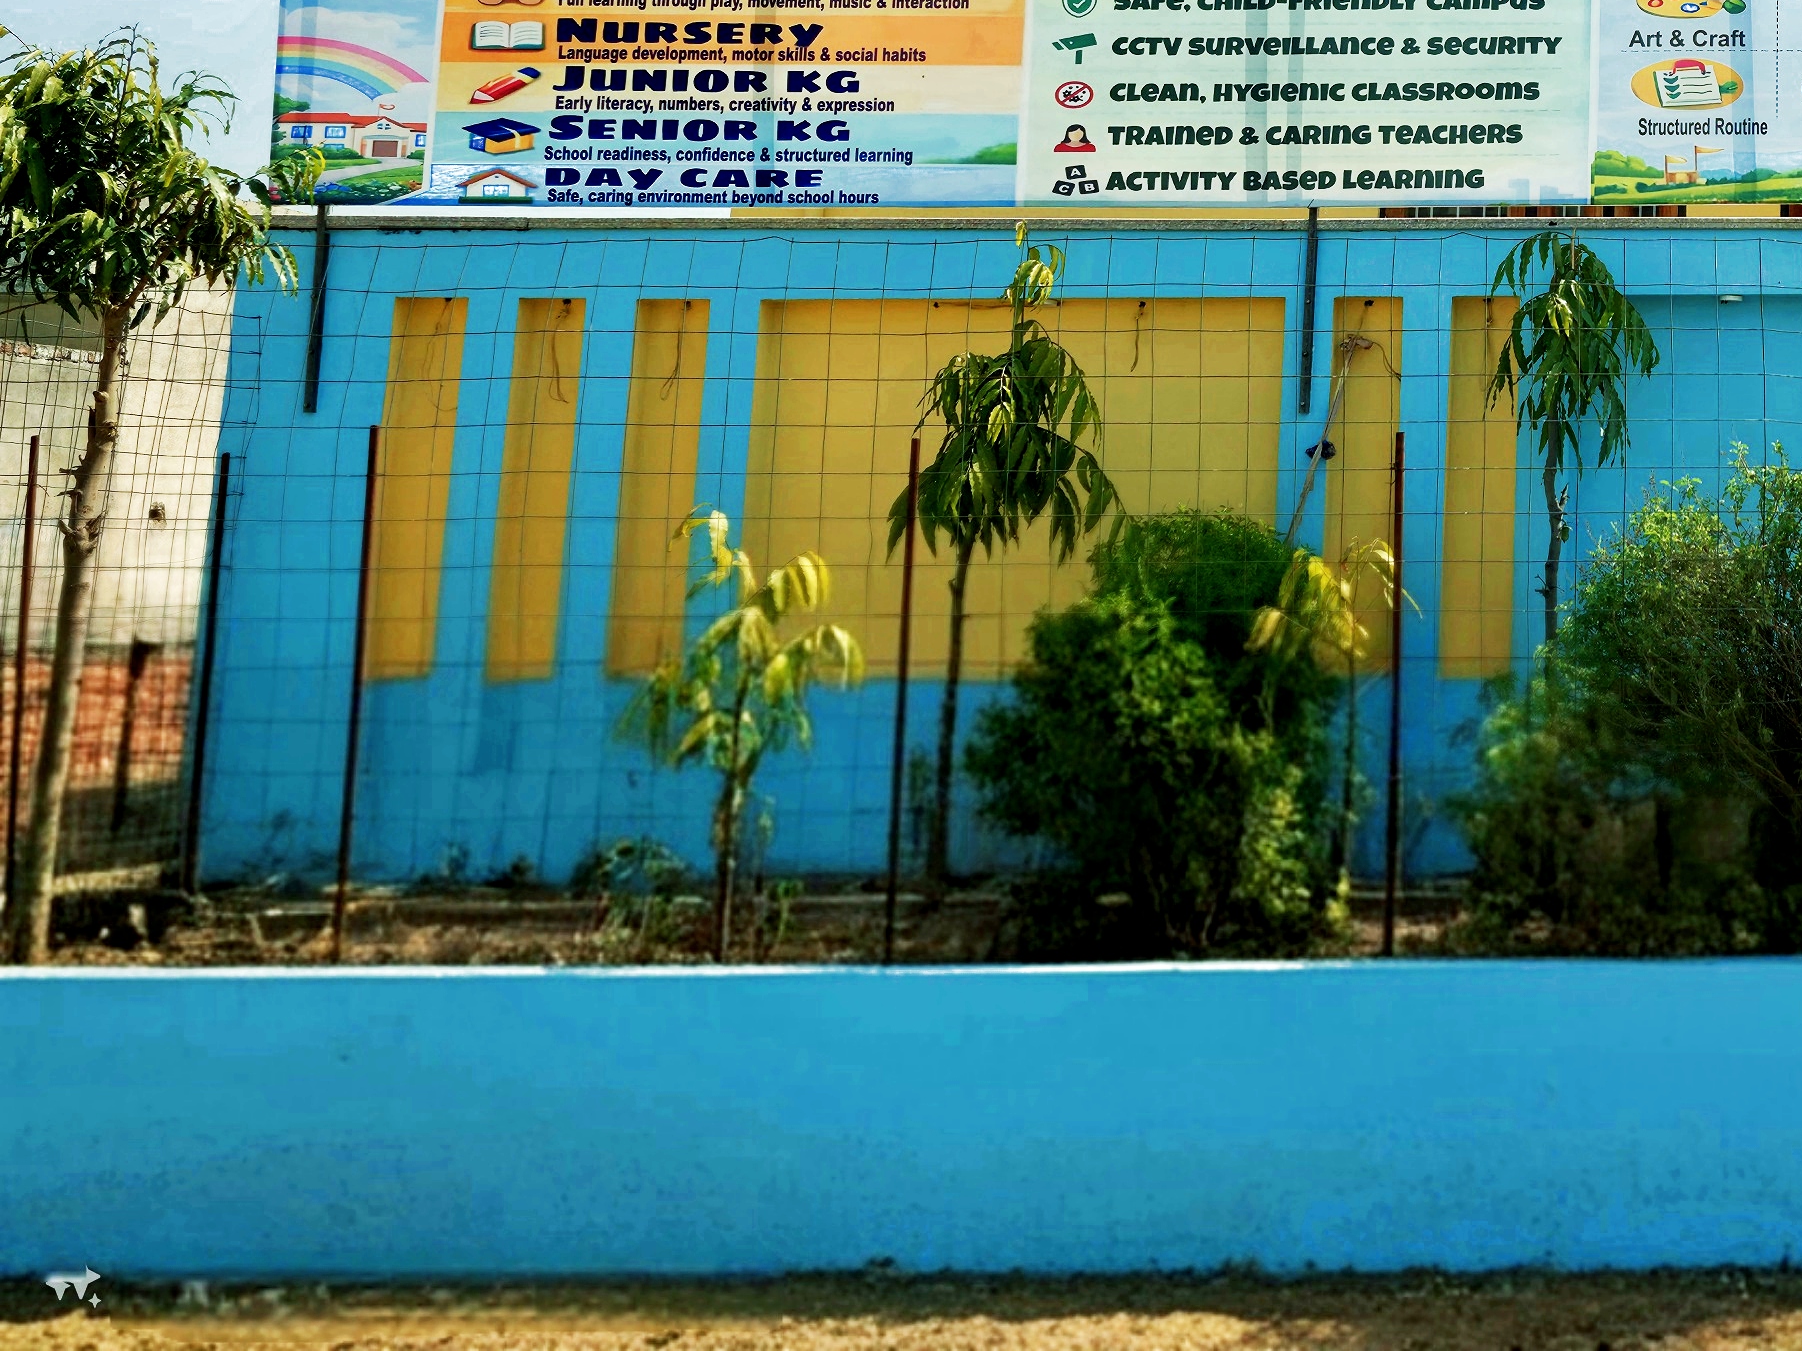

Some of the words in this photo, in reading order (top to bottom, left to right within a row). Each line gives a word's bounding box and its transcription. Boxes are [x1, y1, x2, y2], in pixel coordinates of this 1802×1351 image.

[556, 18, 824, 47] NURSERY
[1628, 29, 1662, 48] Art
[1669, 29, 1685, 48] &
[1692, 29, 1746, 48] Craft
[558, 46, 627, 63] Language
[632, 47, 727, 63] development,
[732, 48, 775, 61] motor
[778, 48, 816, 61] skills
[820, 48, 830, 61] &
[835, 48, 878, 62] social
[882, 47, 927, 62] habits
[1111, 37, 1183, 56] CCTV
[1400, 37, 1421, 55] &
[553, 66, 768, 93] JUNIOR
[787, 70, 860, 94] KG
[555, 96, 592, 113] Early
[596, 96, 654, 114] literacy,
[659, 97, 724, 114] numbers,
[729, 97, 797, 115] creativity
[801, 98, 812, 112] &
[817, 98, 895, 115] expression
[549, 115, 758, 142] SENIOR
[776, 119, 850, 142] KG
[1238, 125, 1260, 145] &
[1638, 117, 1711, 135] Structured
[1715, 117, 1768, 135] Routine
[544, 146, 592, 161] School
[597, 146, 671, 164] readiness,
[676, 147, 755, 162] confidence
[759, 148, 770, 162] &
[775, 148, 850, 162] structured
[855, 148, 913, 165] learning
[545, 167, 663, 190] DAY
[680, 168, 823, 188] CARE
[1070, 167, 1082, 177] A
[1105, 171, 1237, 191] ACTIVITY
[1058, 184, 1070, 193] C
[1084, 183, 1096, 192] B
[547, 189, 584, 205] Safe,
[588, 189, 633, 206] caring
[637, 190, 727, 204] environment
[732, 191, 783, 207] beyond
[787, 191, 834, 204] school
[838, 191, 880, 204] hours
